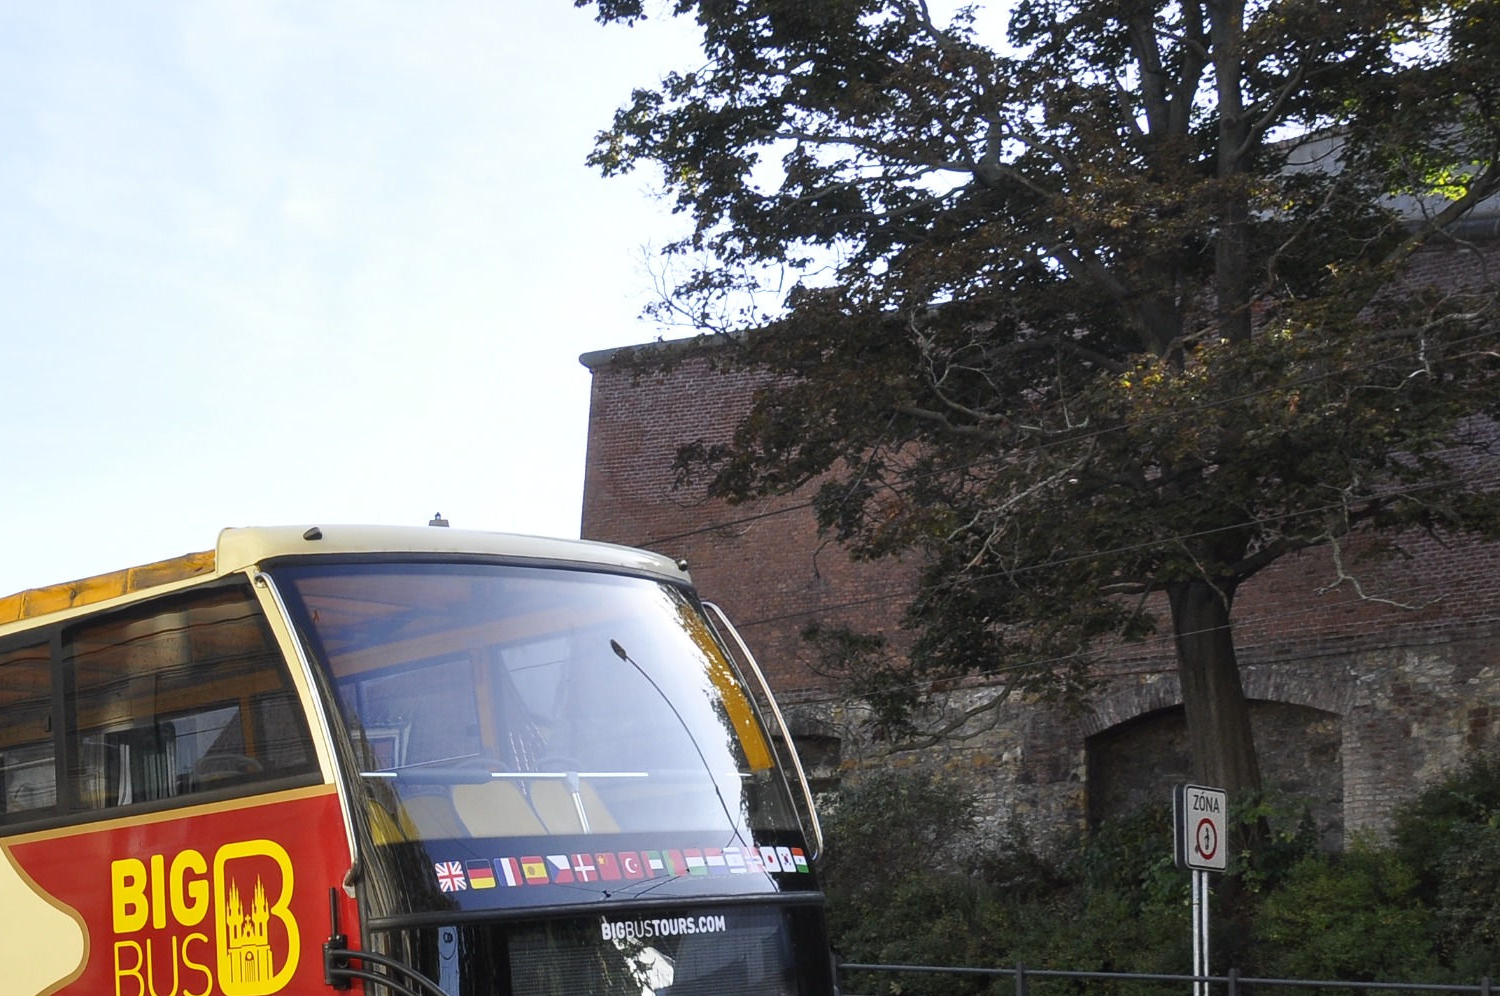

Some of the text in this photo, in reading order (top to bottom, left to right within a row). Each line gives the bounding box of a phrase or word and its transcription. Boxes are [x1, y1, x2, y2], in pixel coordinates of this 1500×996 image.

[1193, 791, 1220, 813] ZÓNA
[111, 849, 209, 933] BIG
[601, 915, 726, 940] BIGBUSTOURS.COM
